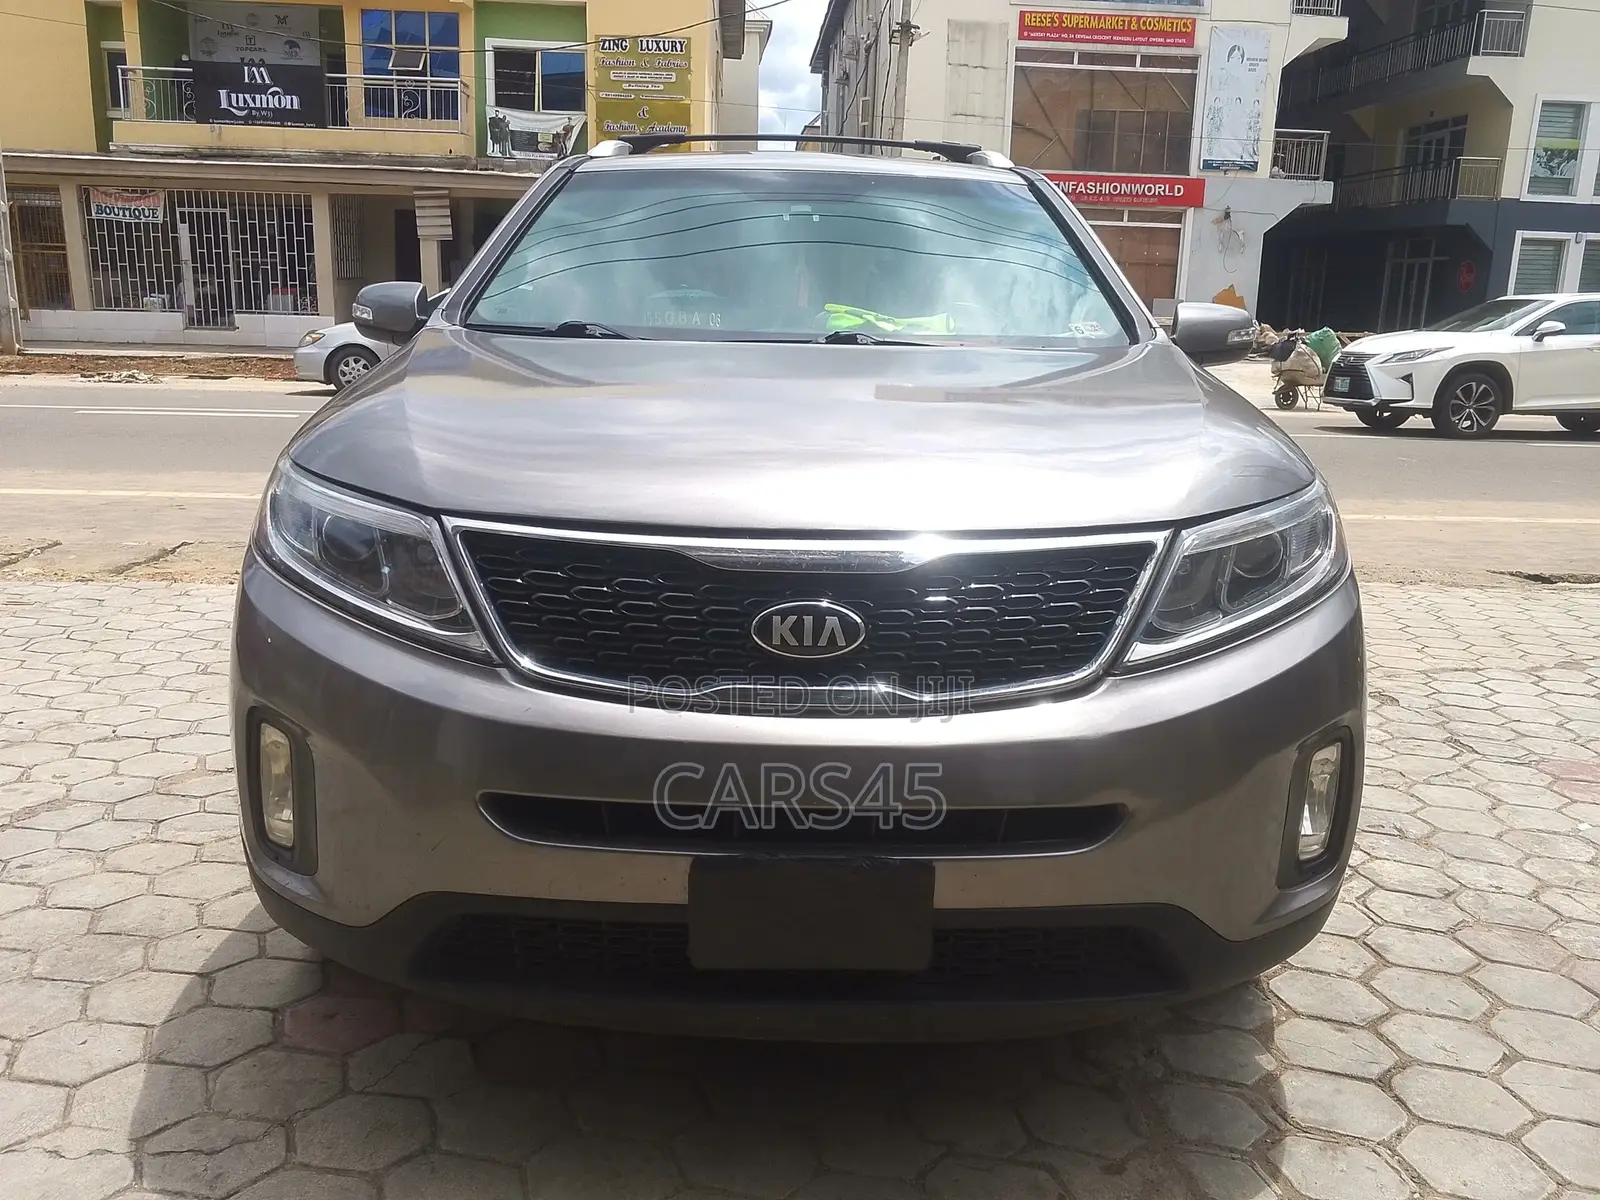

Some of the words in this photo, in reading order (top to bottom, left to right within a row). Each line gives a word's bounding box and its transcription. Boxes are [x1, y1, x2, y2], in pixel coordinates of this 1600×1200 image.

[1024, 13, 1059, 27] REESE'S
[1062, 13, 1130, 30] SUPERMARKET
[1130, 16, 1138, 30] &
[1140, 17, 1192, 33] COSMETICS
[600, 38, 628, 52] ZING
[639, 39, 686, 53] LUXURY
[600, 57, 636, 67] Fashion
[654, 57, 688, 69] Fabrics
[217, 87, 302, 117] Luxmon
[603, 120, 637, 132] Fashion
[95, 204, 159, 220] BOUTIQUE
[772, 615, 847, 646] KIA
